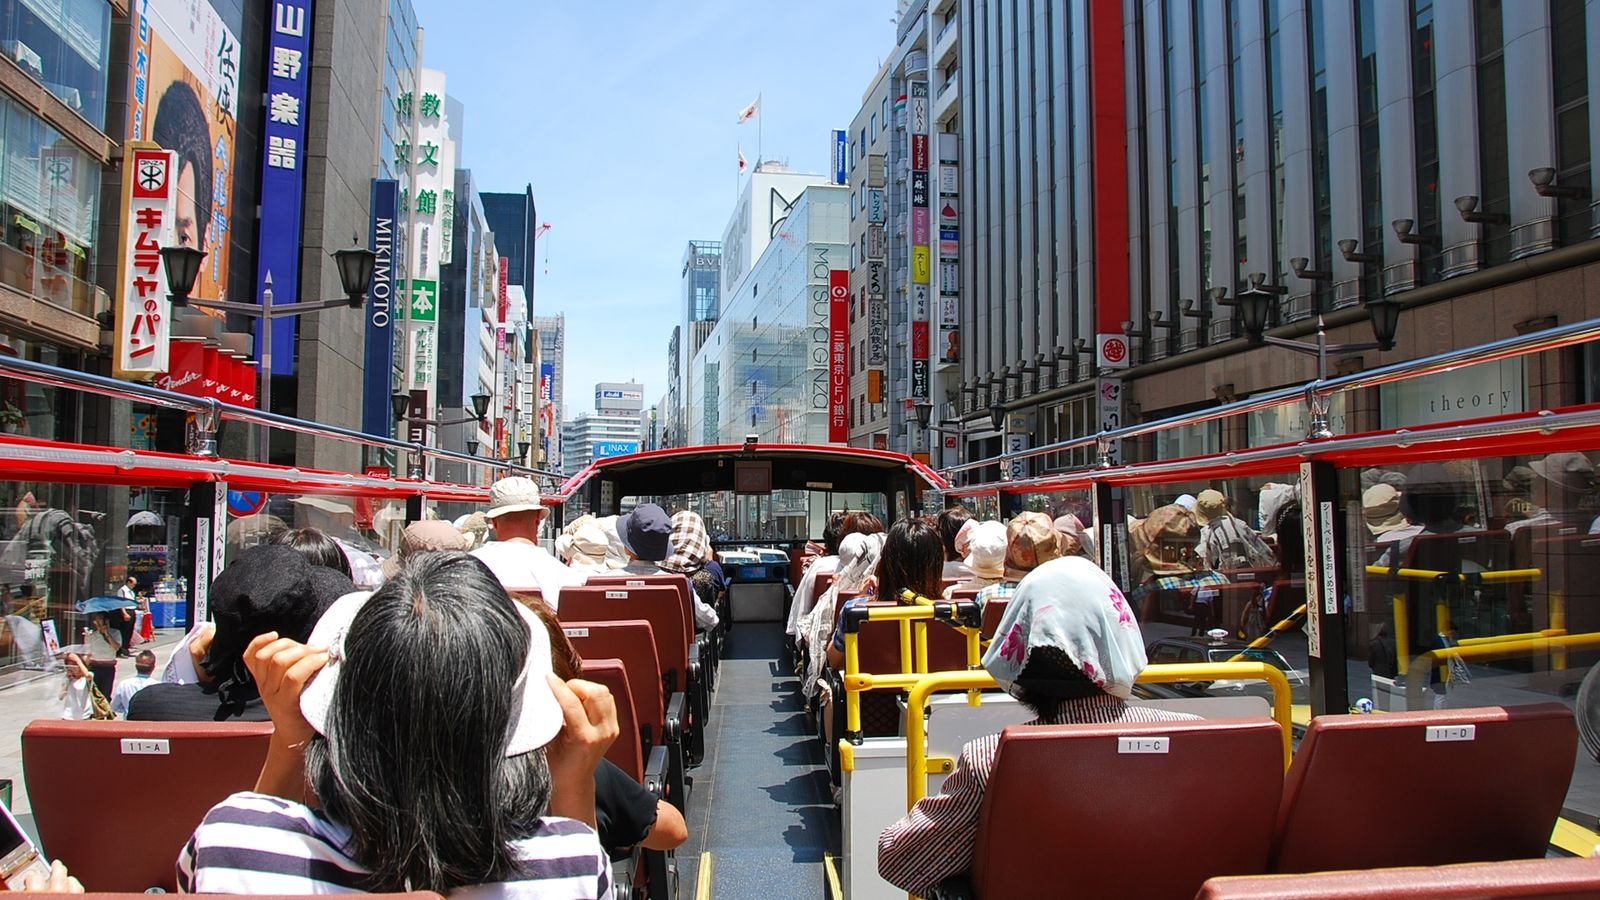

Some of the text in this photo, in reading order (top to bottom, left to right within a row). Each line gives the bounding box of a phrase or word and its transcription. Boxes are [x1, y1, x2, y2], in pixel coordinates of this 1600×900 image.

[268, 2, 305, 170] 山野楽器
[415, 91, 442, 216] 教文館
[130, 207, 163, 359] キムラヤのパン
[372, 217, 392, 329] MIKIMOTO
[412, 286, 434, 315] 本
[415, 328, 426, 383] ナルニア国
[158, 371, 202, 391] Fender
[833, 330, 845, 427] 三菱東京UFJ銀行
[1430, 388, 1512, 413] theory
[1289, 414, 1347, 433] thry
[608, 444, 629, 452] INAX
[130, 742, 160, 751] 11-A
[1128, 741, 1160, 750] 11-C
[1436, 728, 1467, 738] 11-D
